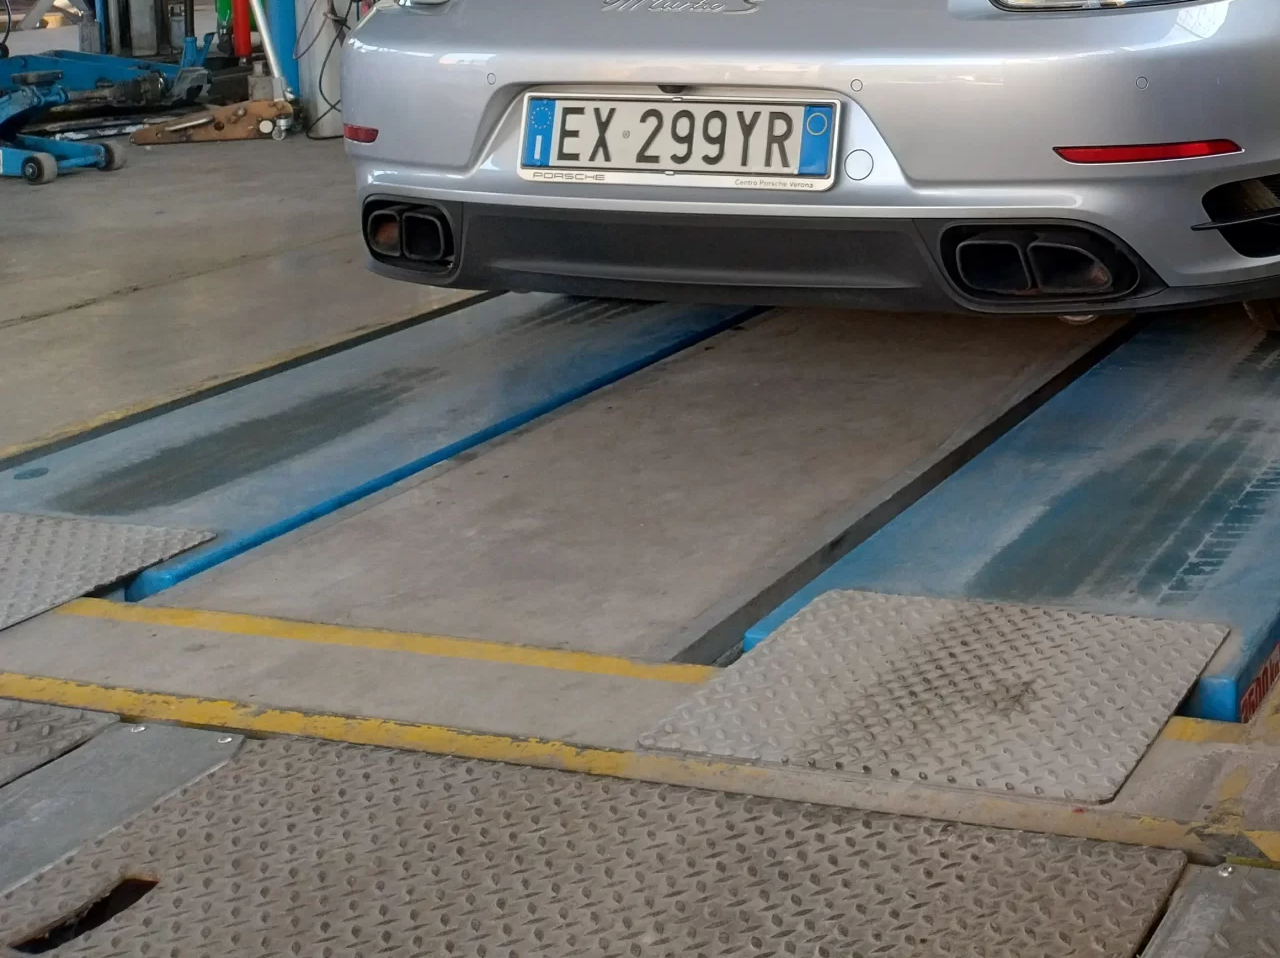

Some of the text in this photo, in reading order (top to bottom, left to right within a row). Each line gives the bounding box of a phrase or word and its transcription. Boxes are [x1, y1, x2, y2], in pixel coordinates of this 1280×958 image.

[556, 106, 793, 168] EX 299YR
[533, 135, 542, 160] I
[532, 171, 605, 181] PORSCHE
[735, 179, 814, 189] Centro Porsche Verona
